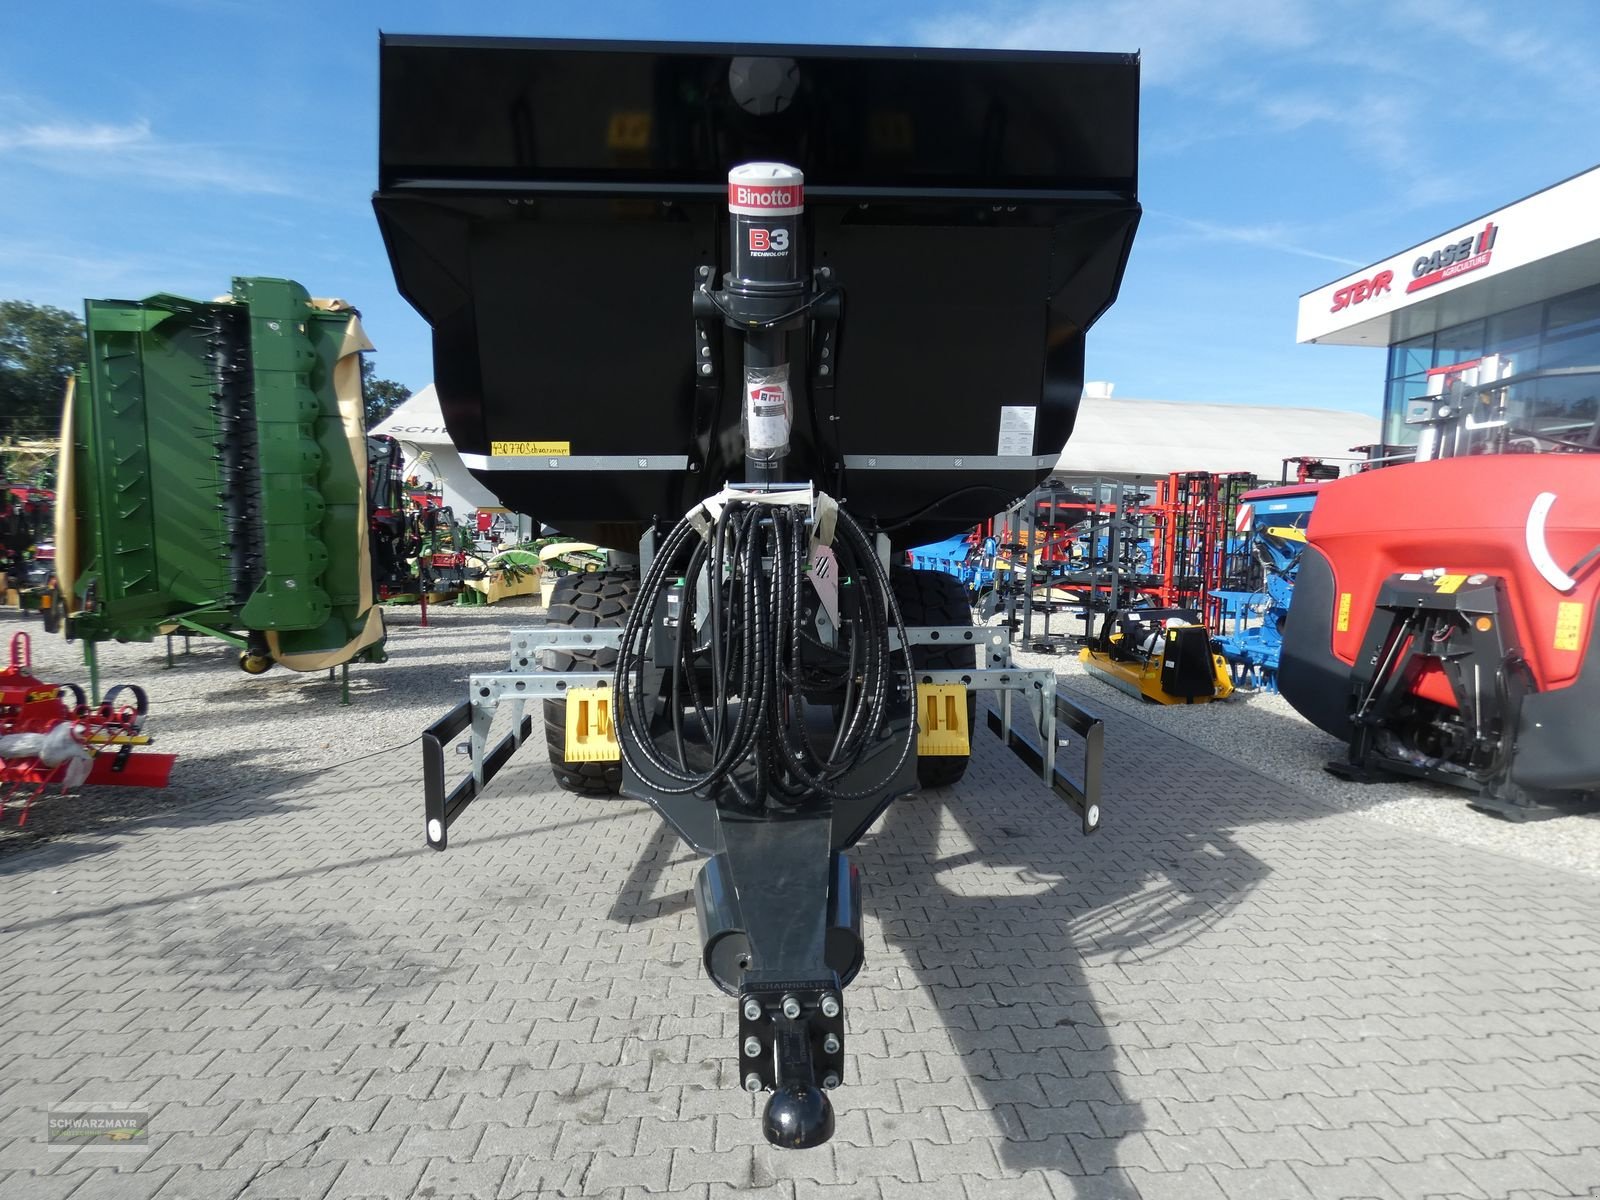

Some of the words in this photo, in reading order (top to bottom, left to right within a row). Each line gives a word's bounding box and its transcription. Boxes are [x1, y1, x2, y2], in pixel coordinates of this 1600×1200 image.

[737, 187, 792, 206] Binotto
[749, 228, 790, 252] B3
[1412, 236, 1475, 279] CASE
[1442, 255, 1487, 277] AGRICULTURE
[1330, 269, 1395, 313] STEYR
